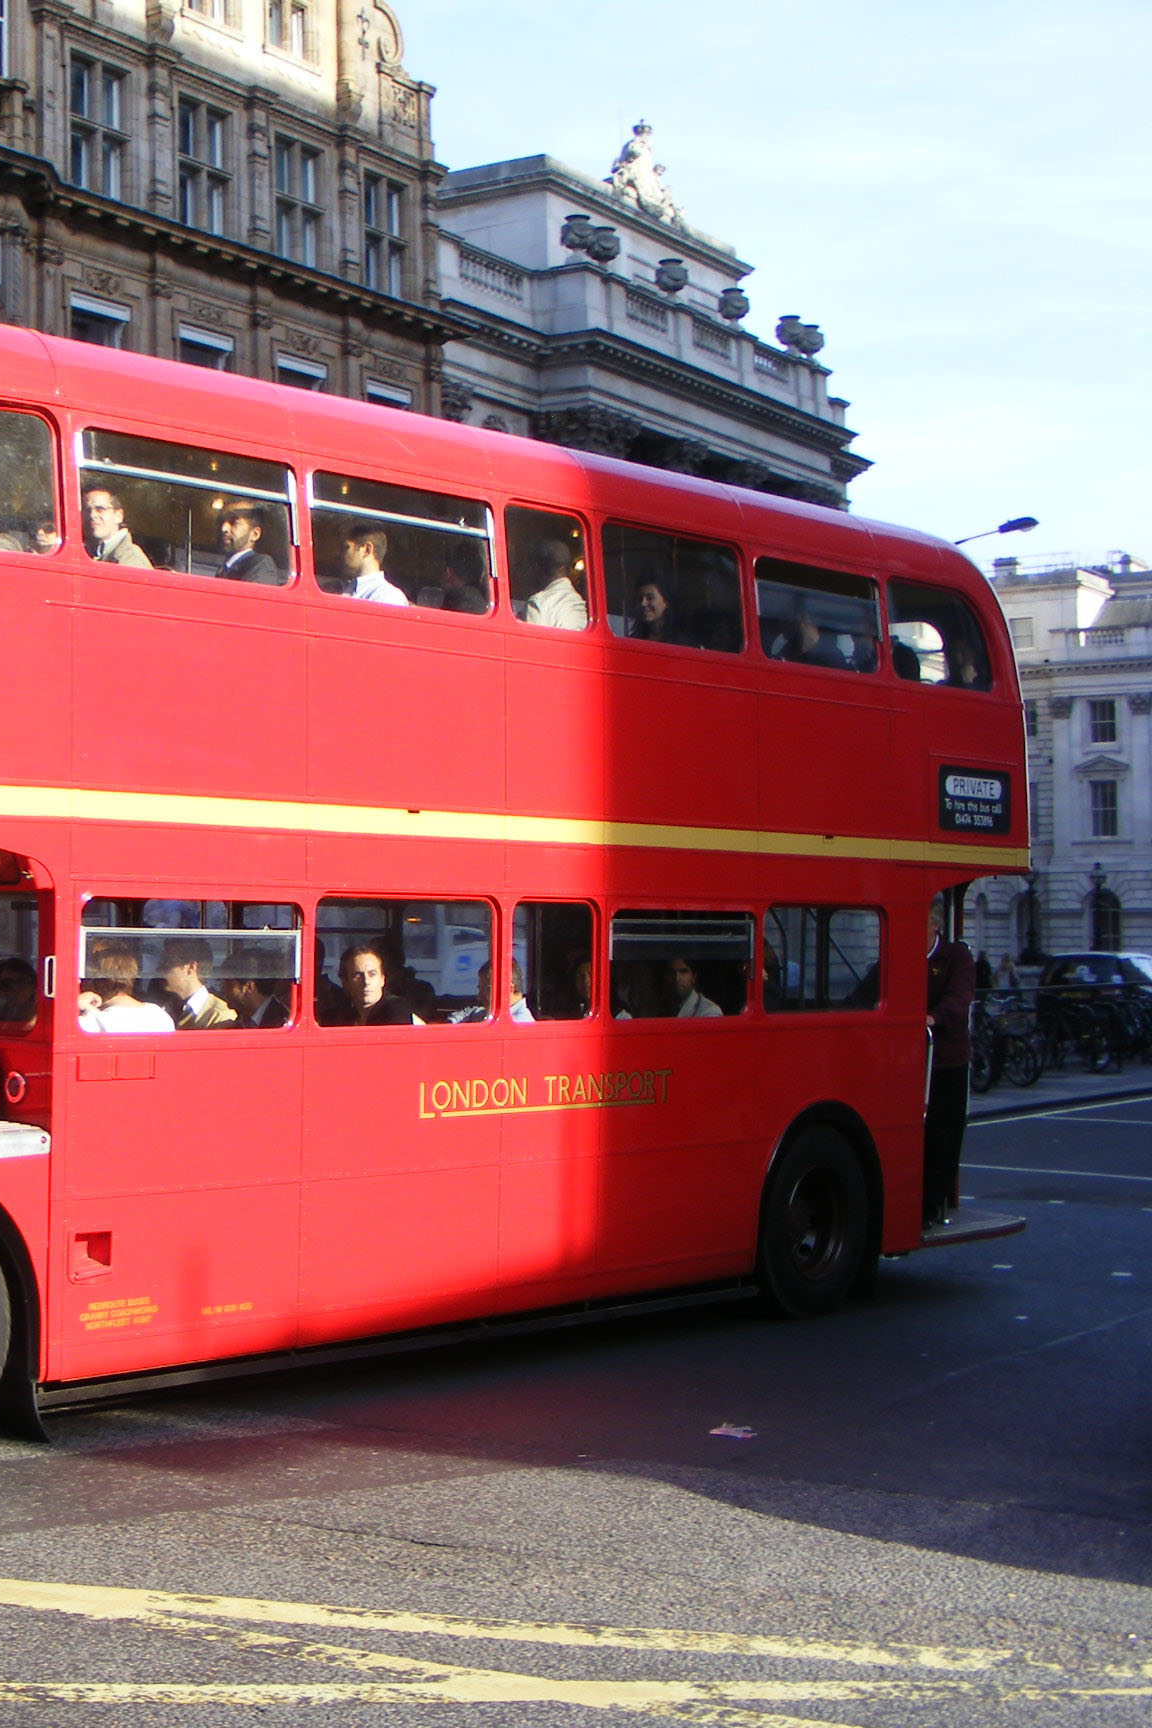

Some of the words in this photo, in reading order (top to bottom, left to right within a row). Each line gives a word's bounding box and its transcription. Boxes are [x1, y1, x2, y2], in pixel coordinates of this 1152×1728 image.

[953, 777, 995, 797] PRIVATE
[945, 798, 953, 810] To
[954, 800, 965, 812] hire
[967, 801, 978, 812] this
[980, 802, 990, 813] bus
[992, 803, 1002, 814] call
[419, 1077, 527, 1118] LONDON
[544, 1069, 672, 1103] TRANSPORT
